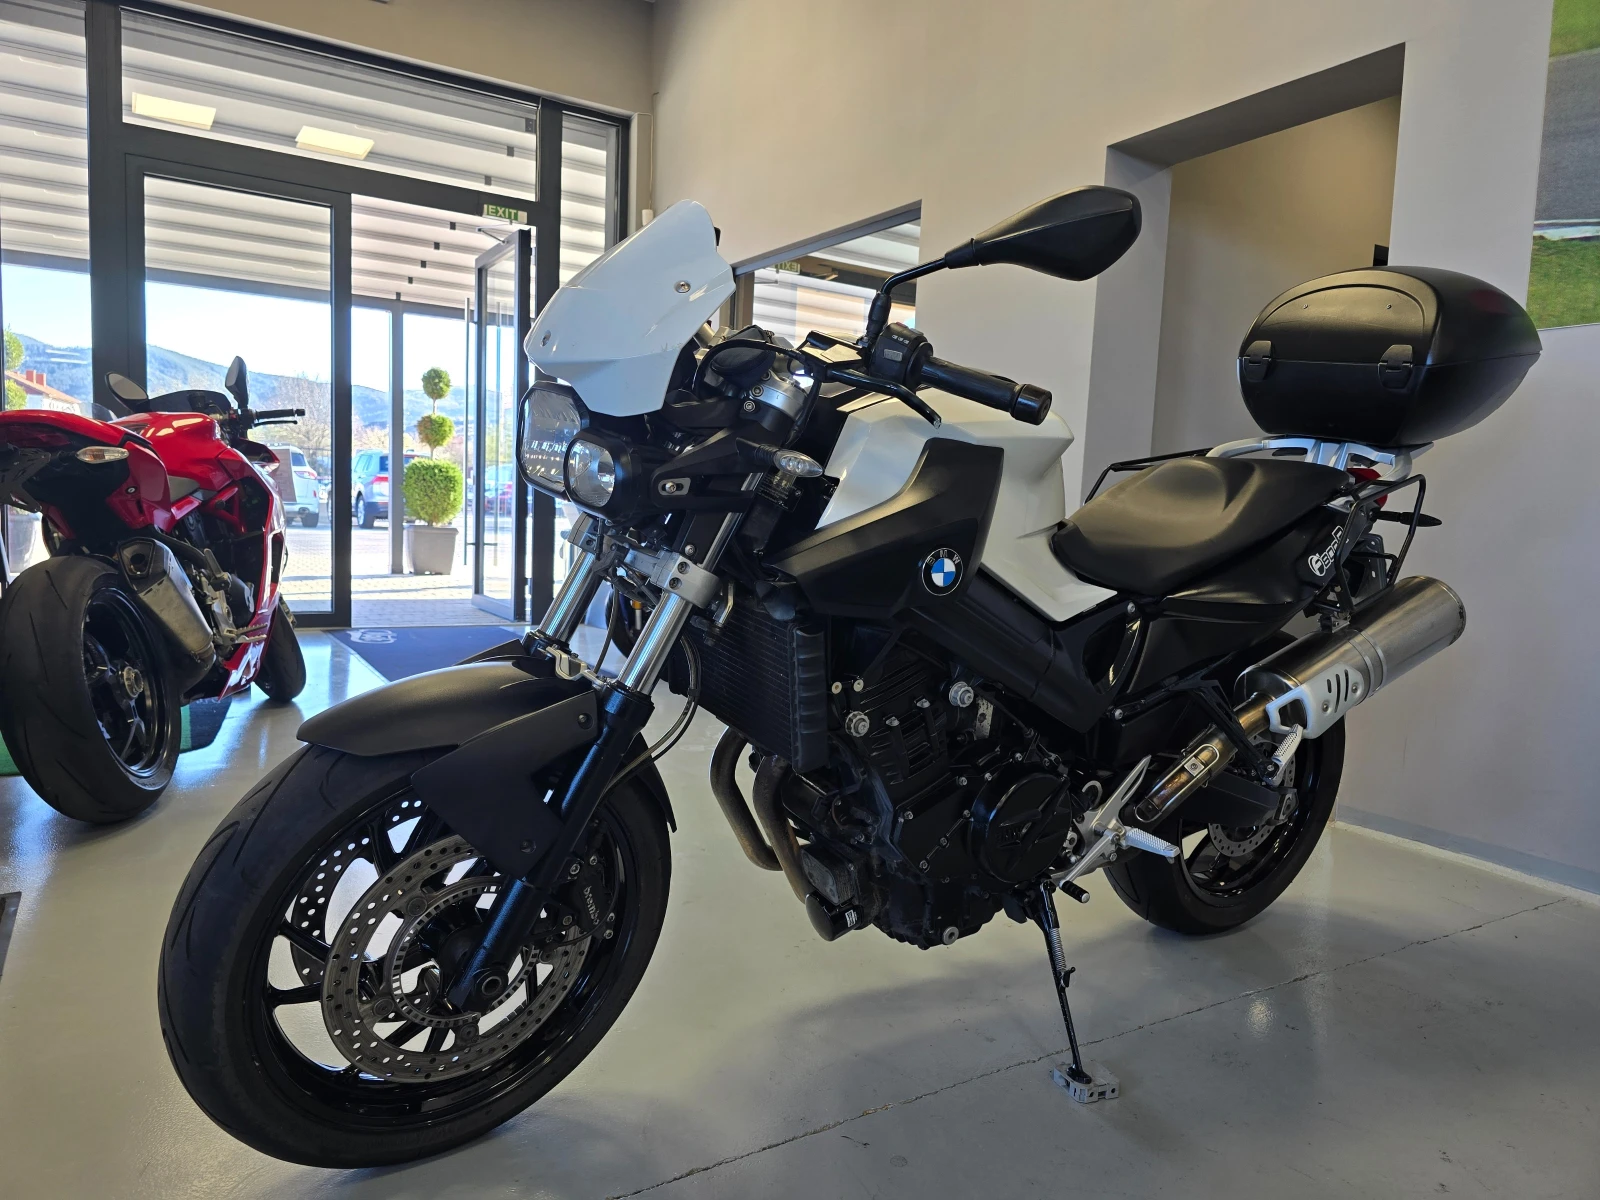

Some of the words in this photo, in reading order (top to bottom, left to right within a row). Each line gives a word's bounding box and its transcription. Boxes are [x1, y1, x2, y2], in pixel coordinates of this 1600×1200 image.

[488, 204, 517, 220] EXIT
[926, 549, 961, 566] BMW
[583, 885, 600, 925] brembo
